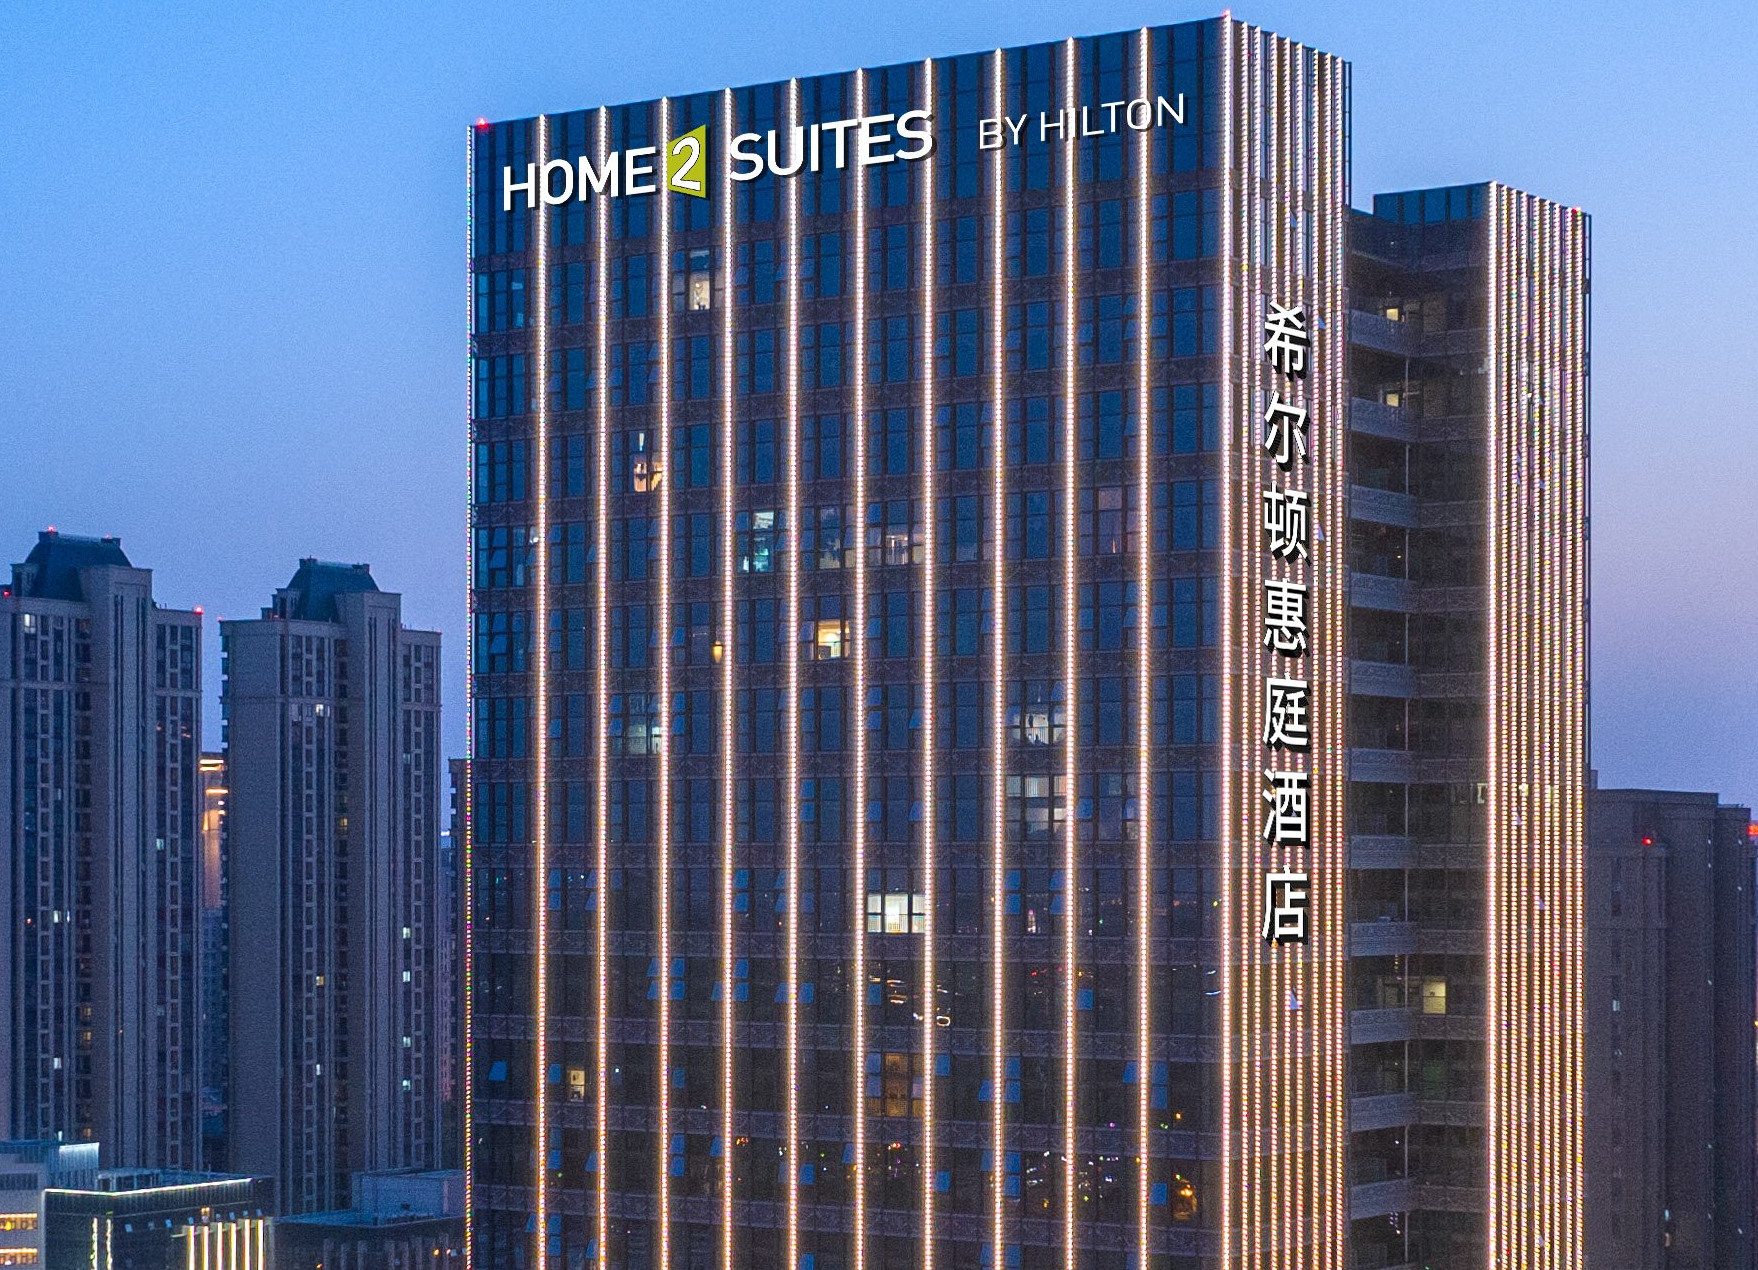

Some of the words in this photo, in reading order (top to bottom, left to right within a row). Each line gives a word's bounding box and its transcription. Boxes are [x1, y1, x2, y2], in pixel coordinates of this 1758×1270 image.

[502, 146, 657, 211] HOME
[670, 135, 702, 193] 2
[729, 109, 934, 182] SUITES
[979, 114, 1027, 150] BY
[1039, 92, 1185, 143] HILTON
[1262, 300, 1310, 942] 希尔顿惠庭酒店
